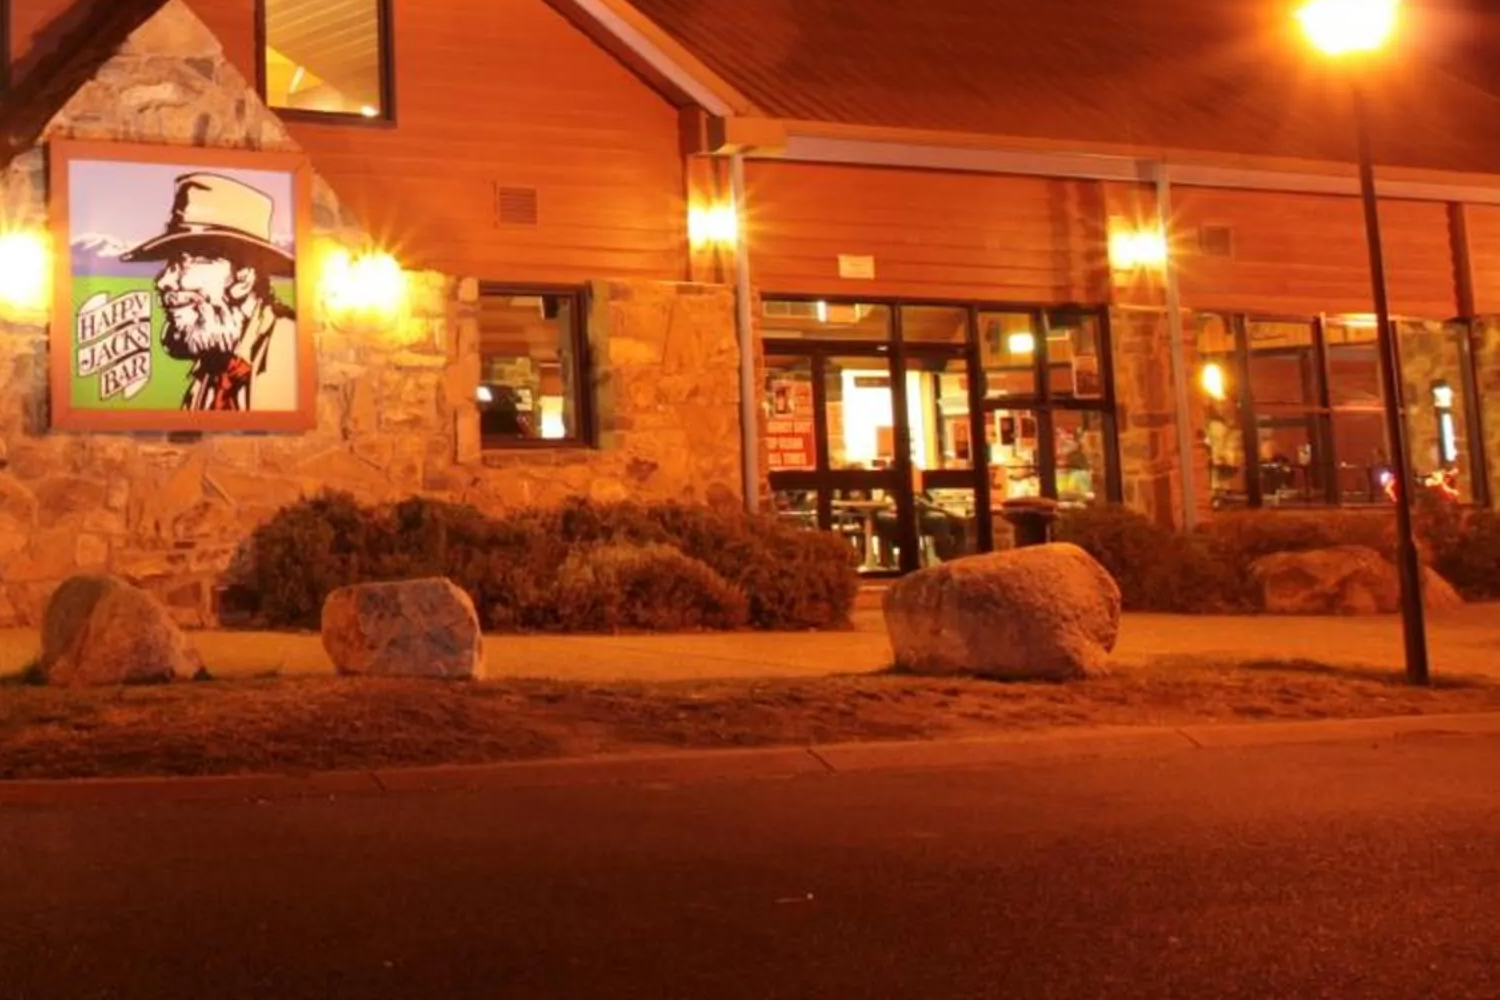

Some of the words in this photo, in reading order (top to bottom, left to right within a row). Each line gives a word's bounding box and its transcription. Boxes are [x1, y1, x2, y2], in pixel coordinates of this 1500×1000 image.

[81, 294, 148, 340] HAPPY
[81, 323, 149, 371] JACKS
[104, 355, 147, 394] BAR
